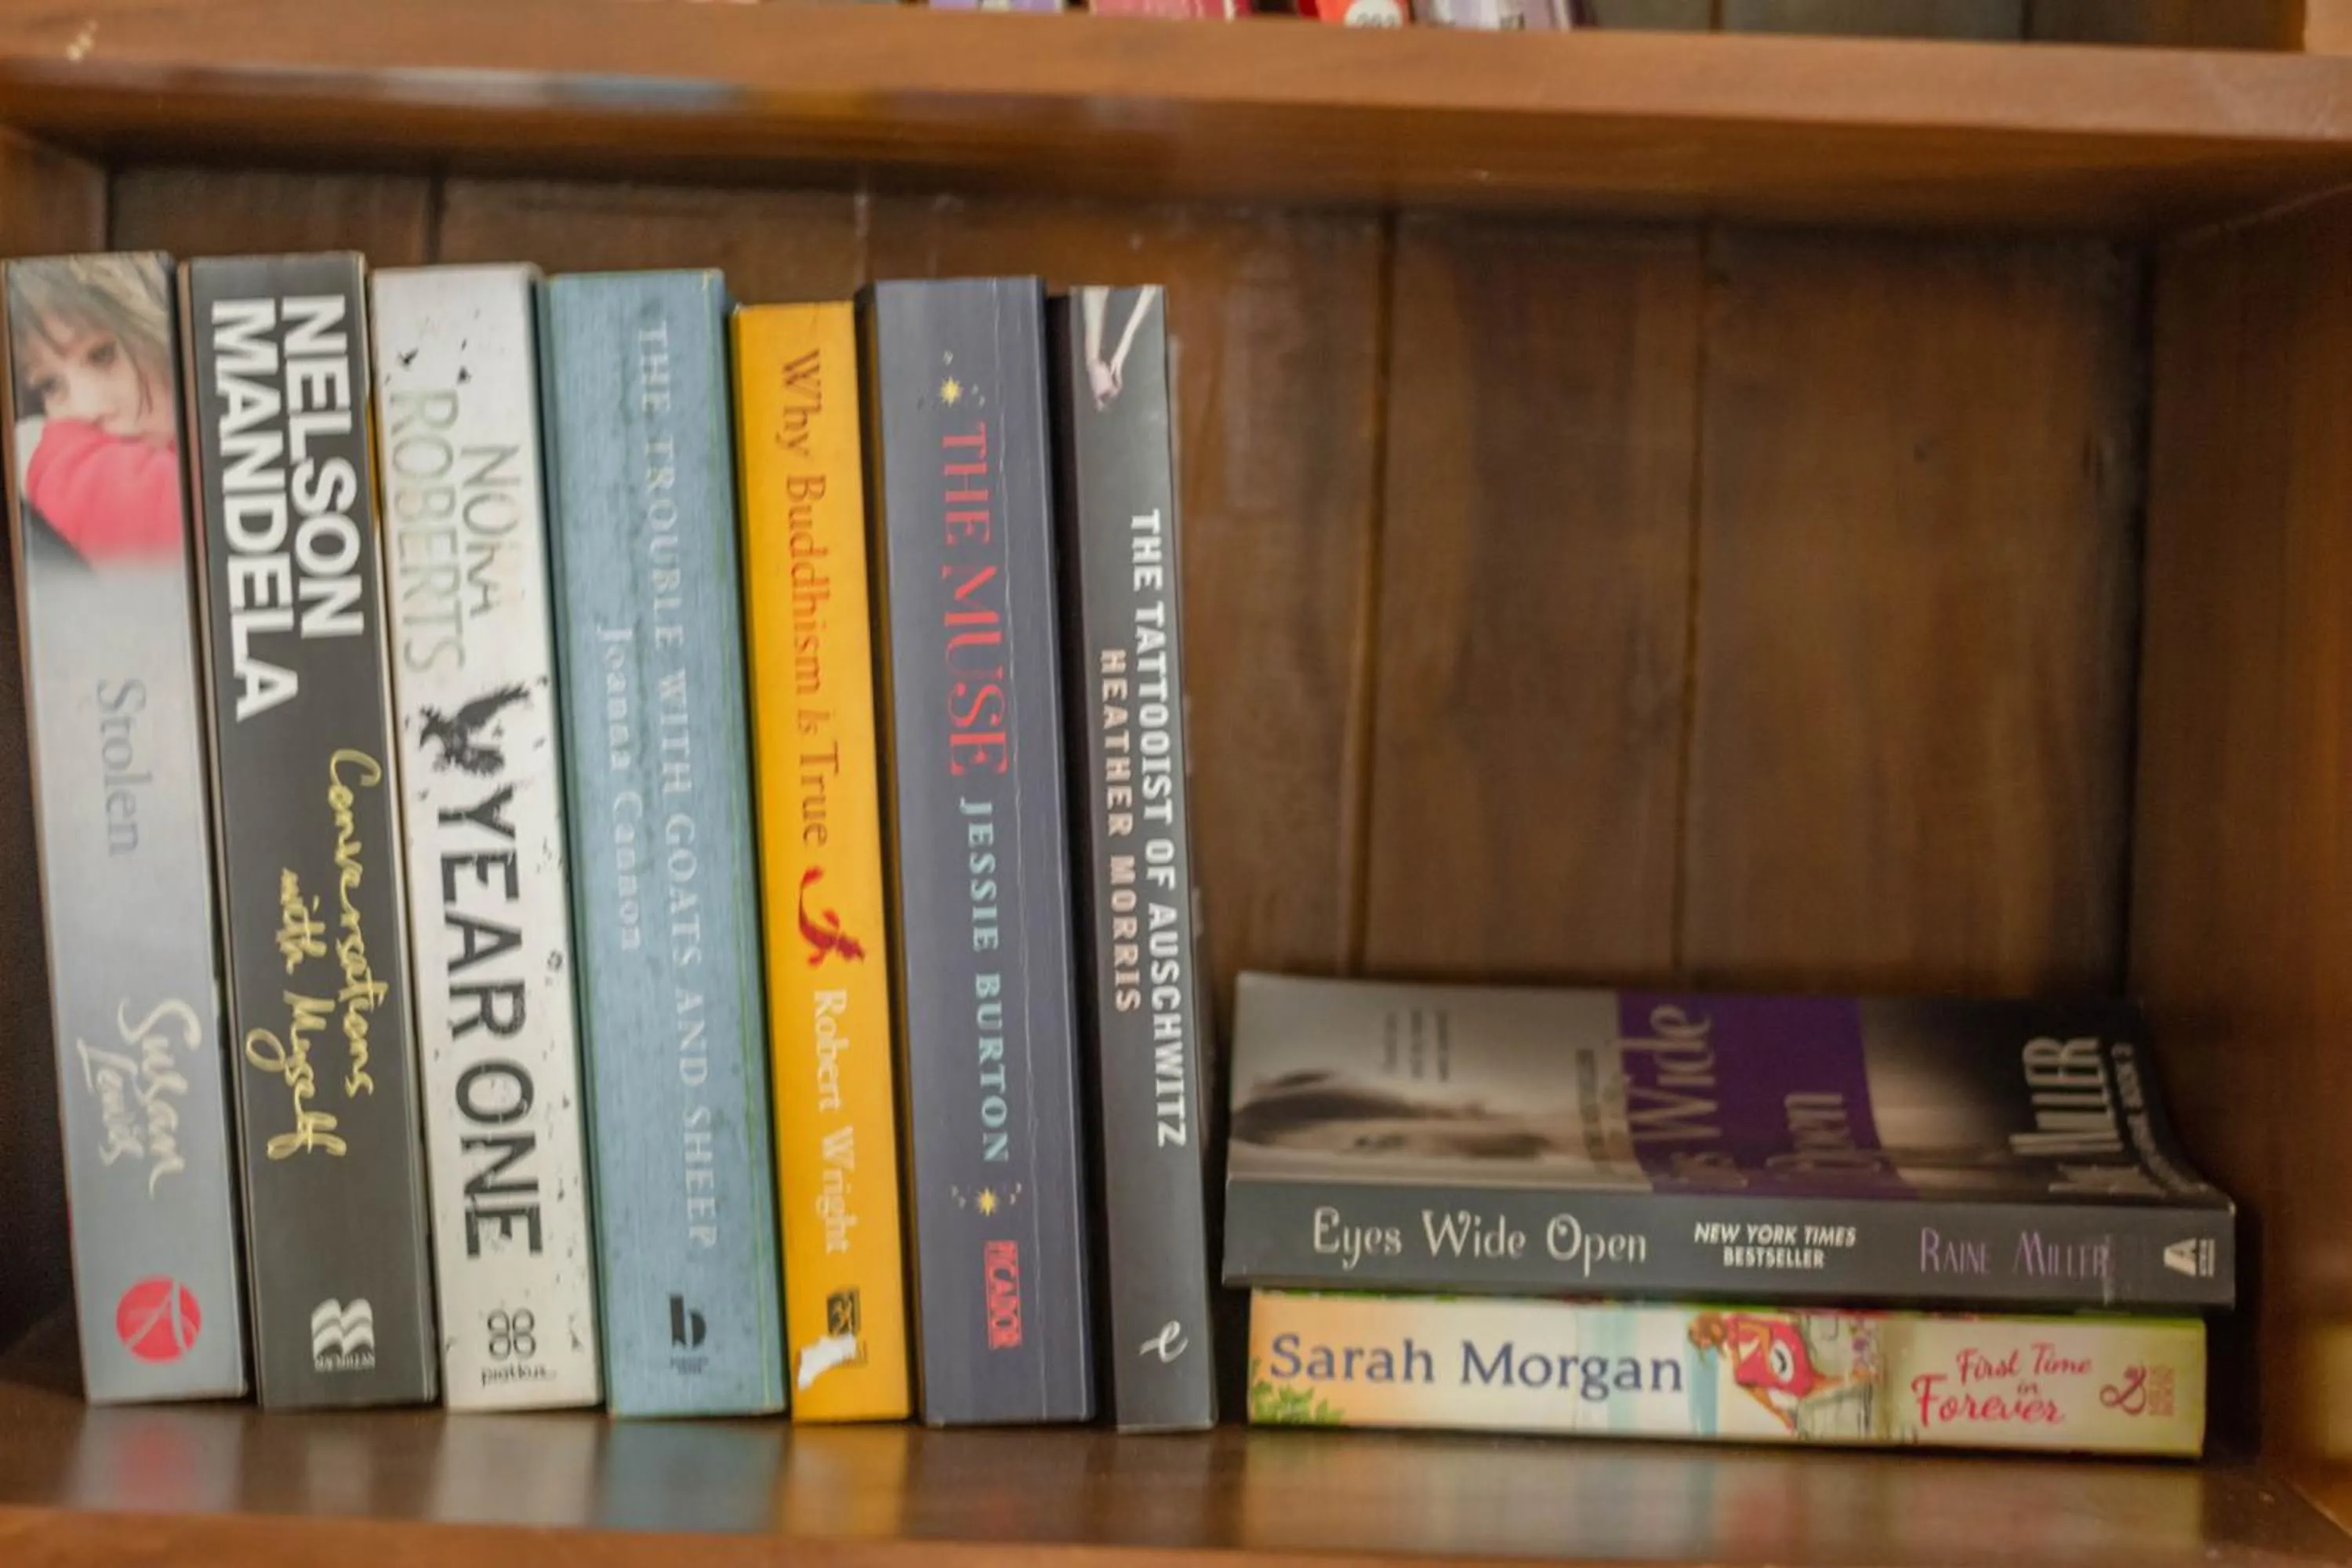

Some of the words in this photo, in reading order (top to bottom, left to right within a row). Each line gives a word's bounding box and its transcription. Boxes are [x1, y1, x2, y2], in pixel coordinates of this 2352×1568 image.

[638, 319, 672, 414] THE
[775, 348, 822, 458] Why
[212, 298, 298, 723] MANDELA
[282, 294, 365, 639] NELSON
[389, 390, 465, 674] ROBERTS
[941, 420, 993, 546] THE
[644, 434, 684, 650] TROUBLE
[786, 473, 832, 696] Buddhism
[1130, 508, 1163, 593] THE
[659, 667, 692, 793] WITH
[941, 564, 1009, 777] MUSE
[1100, 648, 1135, 837] HEATHER
[1134, 600, 1174, 826] TATTOOIST
[96, 677, 153, 857] Stolen
[799, 739, 840, 848] True
[328, 748, 389, 1098] Conversations
[437, 784, 527, 1042] YEAR
[665, 812, 702, 967] GOATS
[959, 796, 1000, 953] JESSIE
[1109, 855, 1142, 1013] MORRIS
[1145, 838, 1175, 891] OF
[674, 985, 709, 1087] AND
[813, 988, 850, 1113] Robert
[975, 972, 1011, 1162] BURTON
[1148, 902, 1187, 1149] AUSCHWITZ
[455, 1060, 543, 1260] ONE
[682, 1105, 718, 1250] SHEEP
[814, 1126, 858, 1256] Wright
[1693, 1221, 1741, 1245] NEW
[1746, 1223, 1798, 1247] YORK
[1804, 1225, 1857, 1248] TIMES
[1312, 1205, 1403, 1272] Eyes
[1421, 1209, 1526, 1259] Wide
[1545, 1213, 1646, 1278] Open
[1722, 1245, 1826, 1269] BESTSELLER
[1269, 1332, 1436, 1384] Sarah
[1460, 1338, 1684, 1403] Morgan
[1910, 1373, 2065, 1428] Forever
[1956, 1346, 2020, 1387] First
[2031, 1341, 2093, 1377] Time
